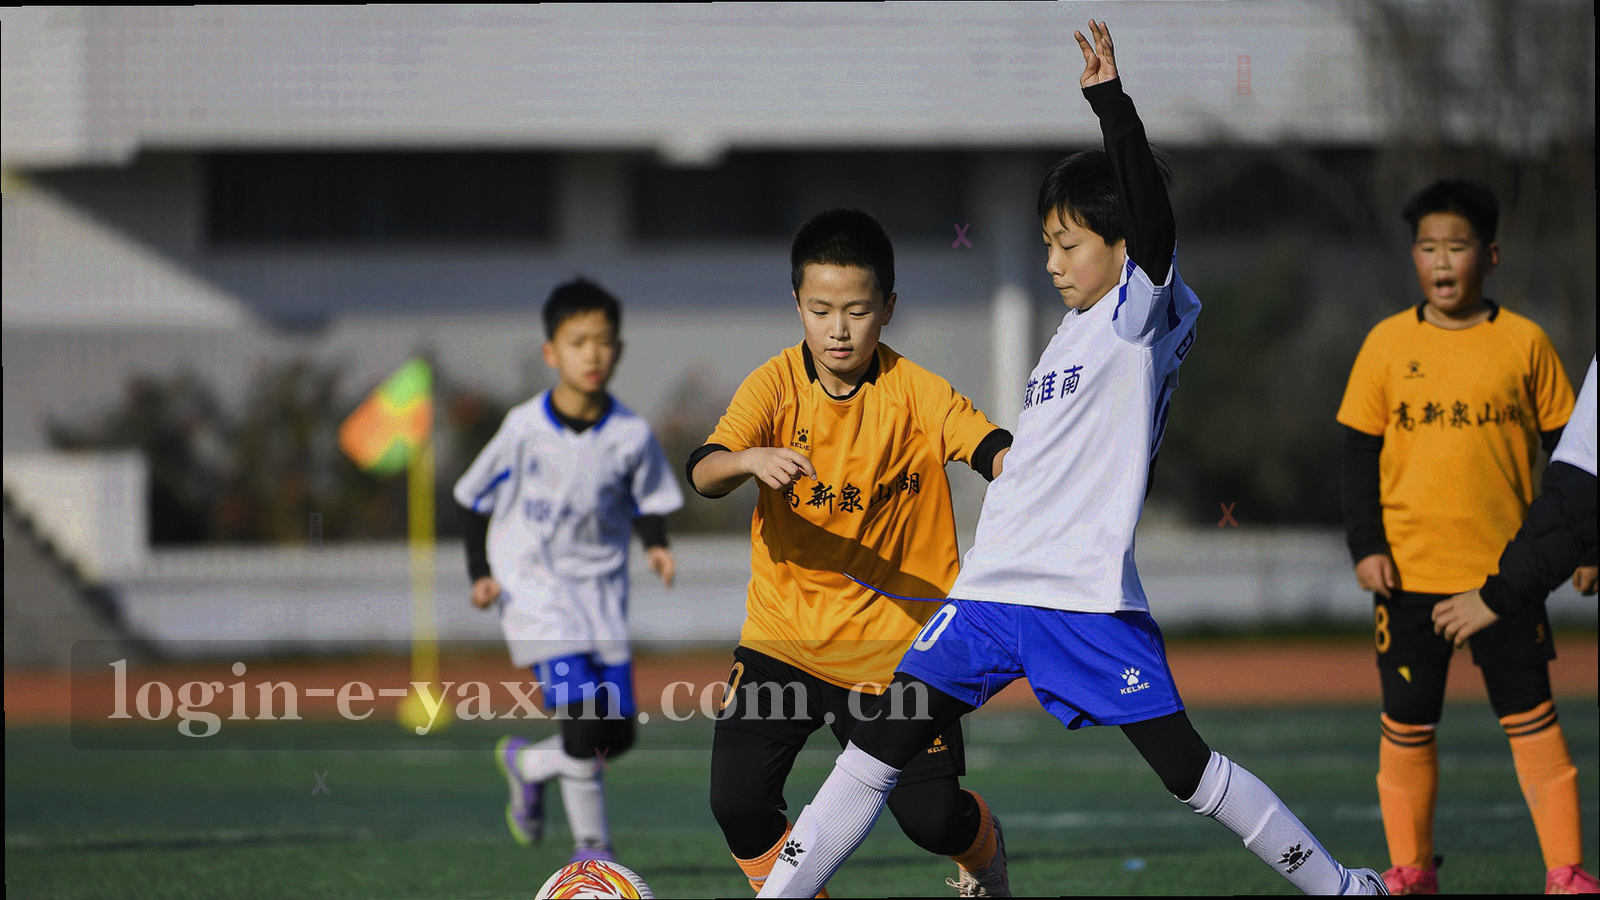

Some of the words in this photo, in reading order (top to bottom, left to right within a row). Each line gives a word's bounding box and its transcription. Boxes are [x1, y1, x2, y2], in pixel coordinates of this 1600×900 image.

[1375, 604, 1391, 653] 8
[1120, 681, 1150, 695] KELME
[1286, 848, 1314, 874] KELME
